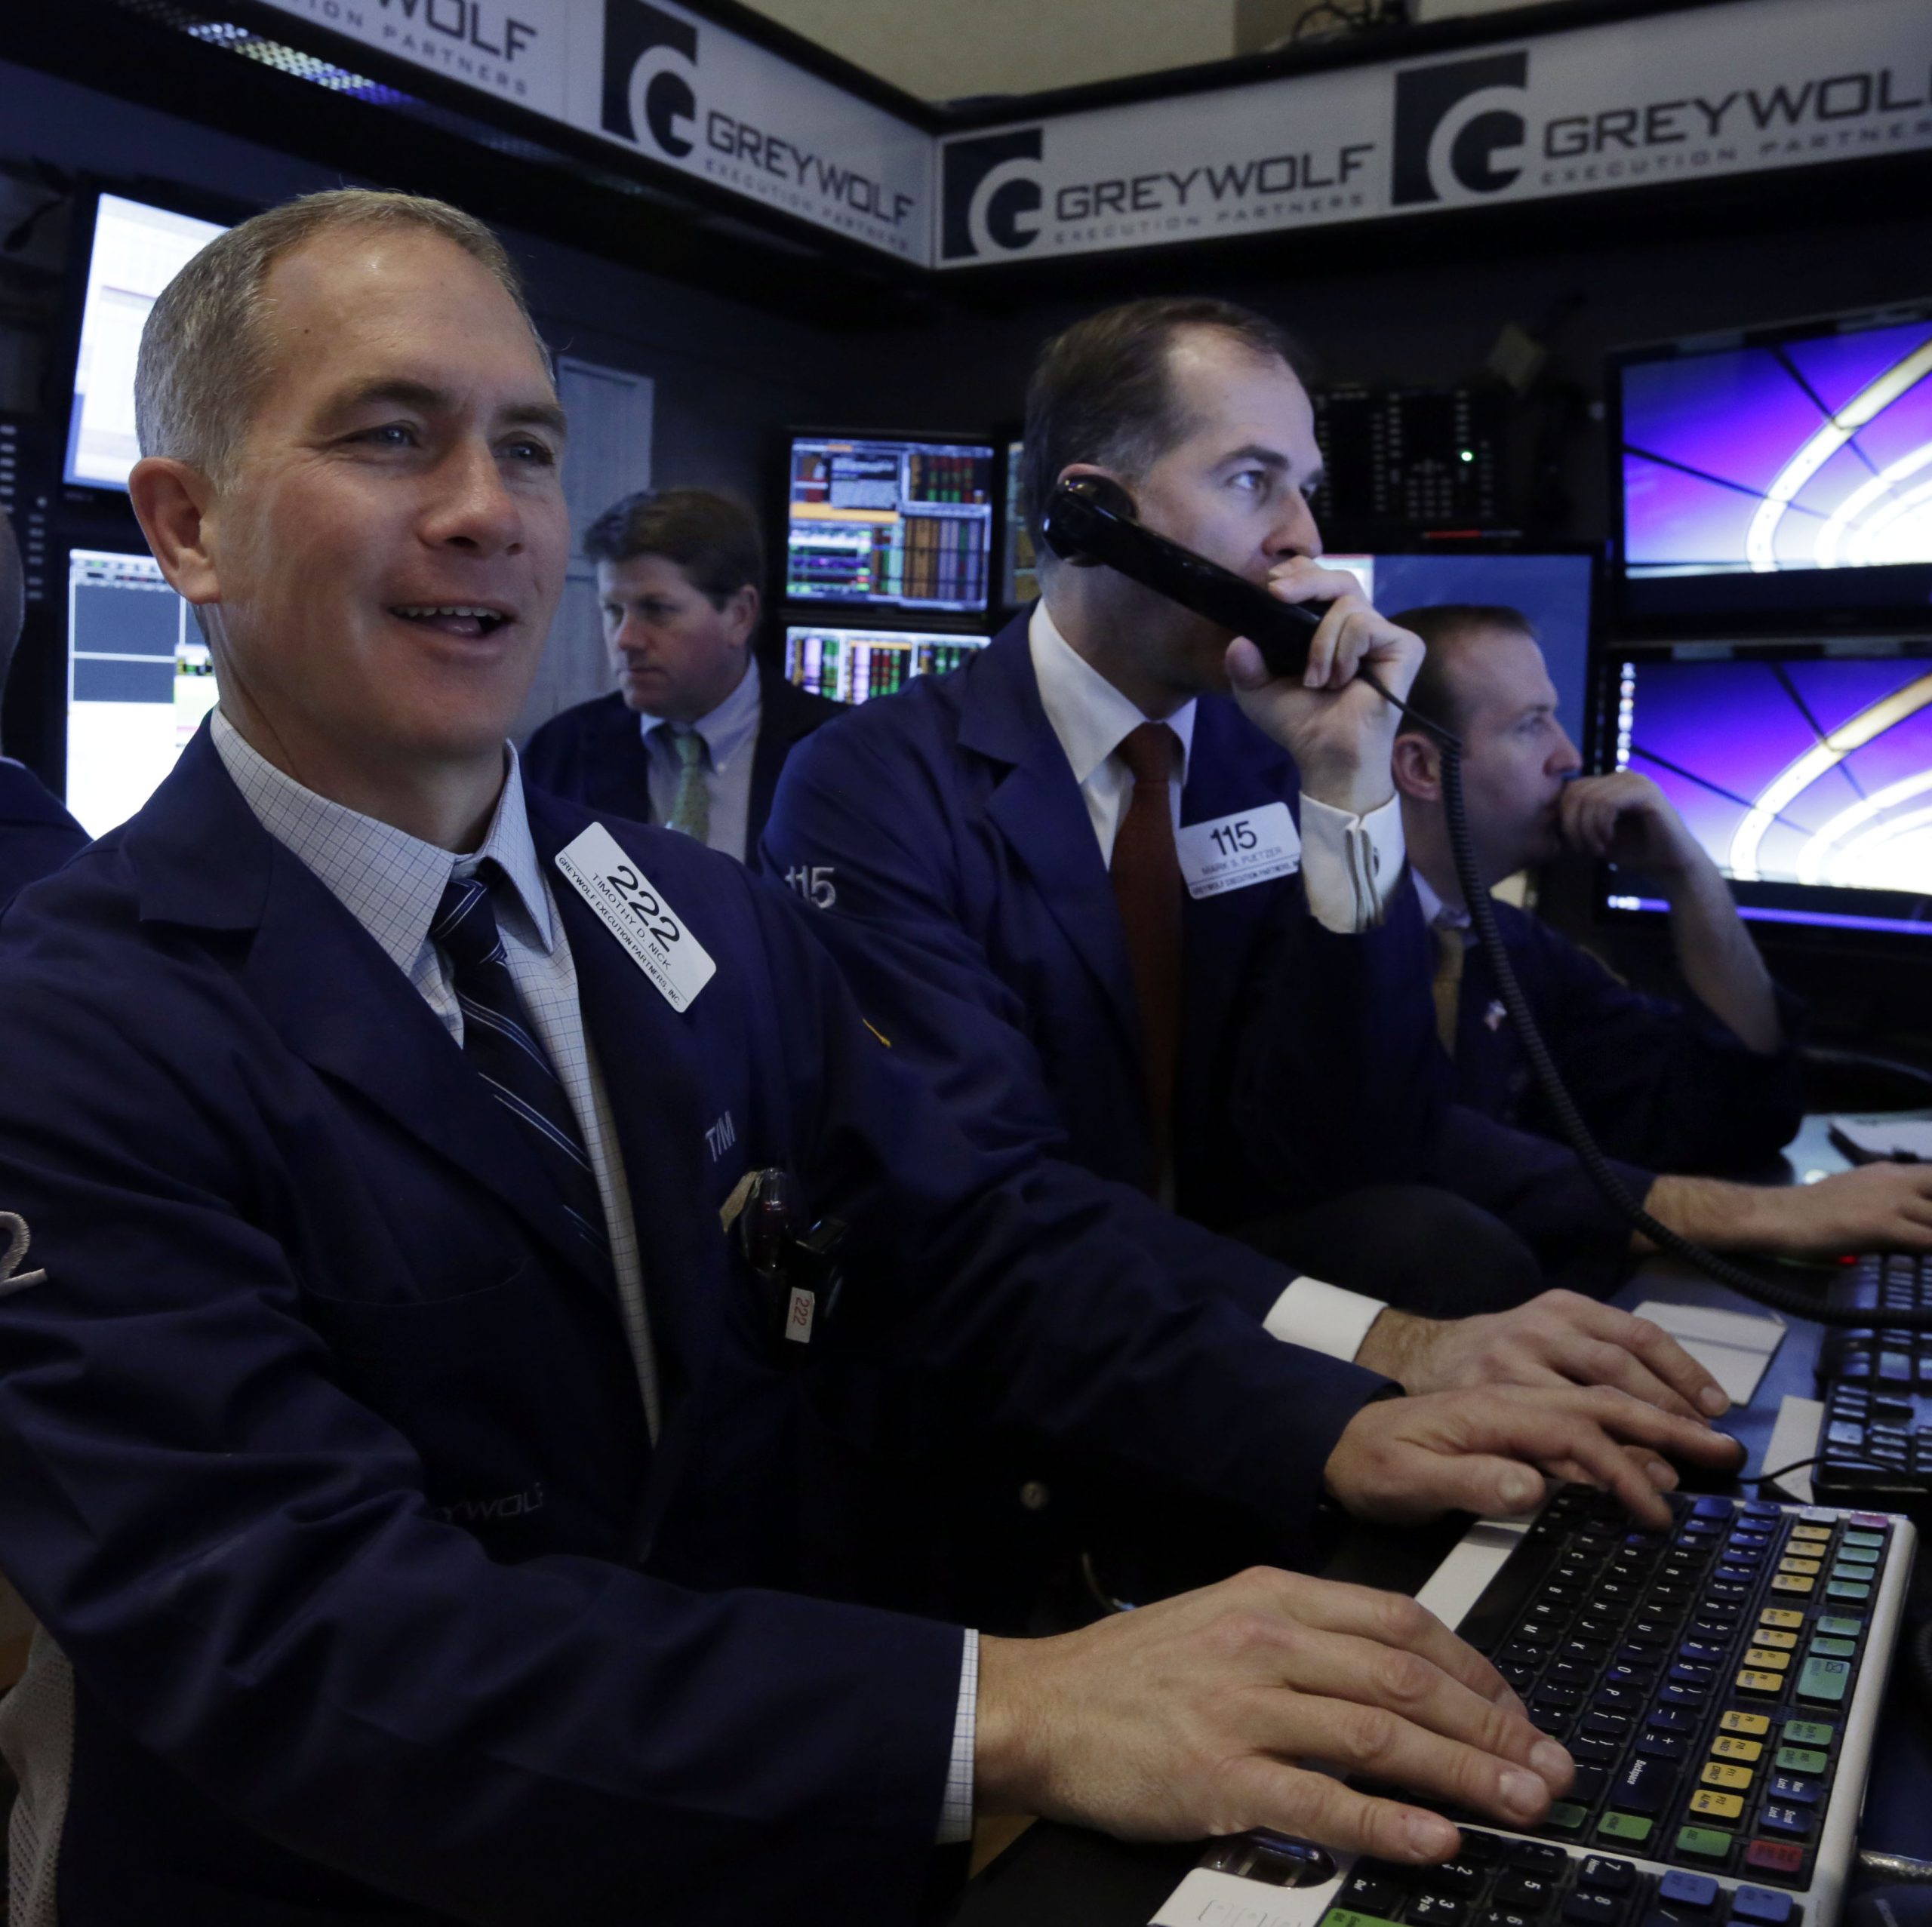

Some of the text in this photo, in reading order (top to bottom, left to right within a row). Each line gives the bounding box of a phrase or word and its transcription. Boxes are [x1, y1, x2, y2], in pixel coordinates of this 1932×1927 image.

[380, 0, 537, 62] OLF
[1543, 69, 1932, 159] GREYWOL
[706, 110, 914, 224] GREYWOLF
[1540, 149, 1735, 186] EXECUTION
[1057, 143, 1375, 221] GREYWOLF
[1217, 195, 1364, 221] PARTNERS
[1211, 821, 1257, 856] 115
[558, 857, 596, 901] GREYWOLF
[595, 901, 632, 945] EXECUTION
[607, 865, 680, 952] 222
[592, 872, 672, 970] TIMOTHY D. NICK
[705, 1111, 736, 1162] TIM
[794, 1297, 810, 1326] 222
[1524, 1624, 1537, 1633] M
[1626, 1760, 1647, 1785] Backspace
[1457, 1866, 1472, 1875] 2
[1585, 1858, 1598, 1874] Home
[1605, 1862, 1621, 1870] 7
[1524, 1881, 1540, 1889] 5
[1439, 1900, 1454, 1908] 3
[1595, 1896, 1611, 1904] 8
[1507, 1916, 1522, 1925] 6
